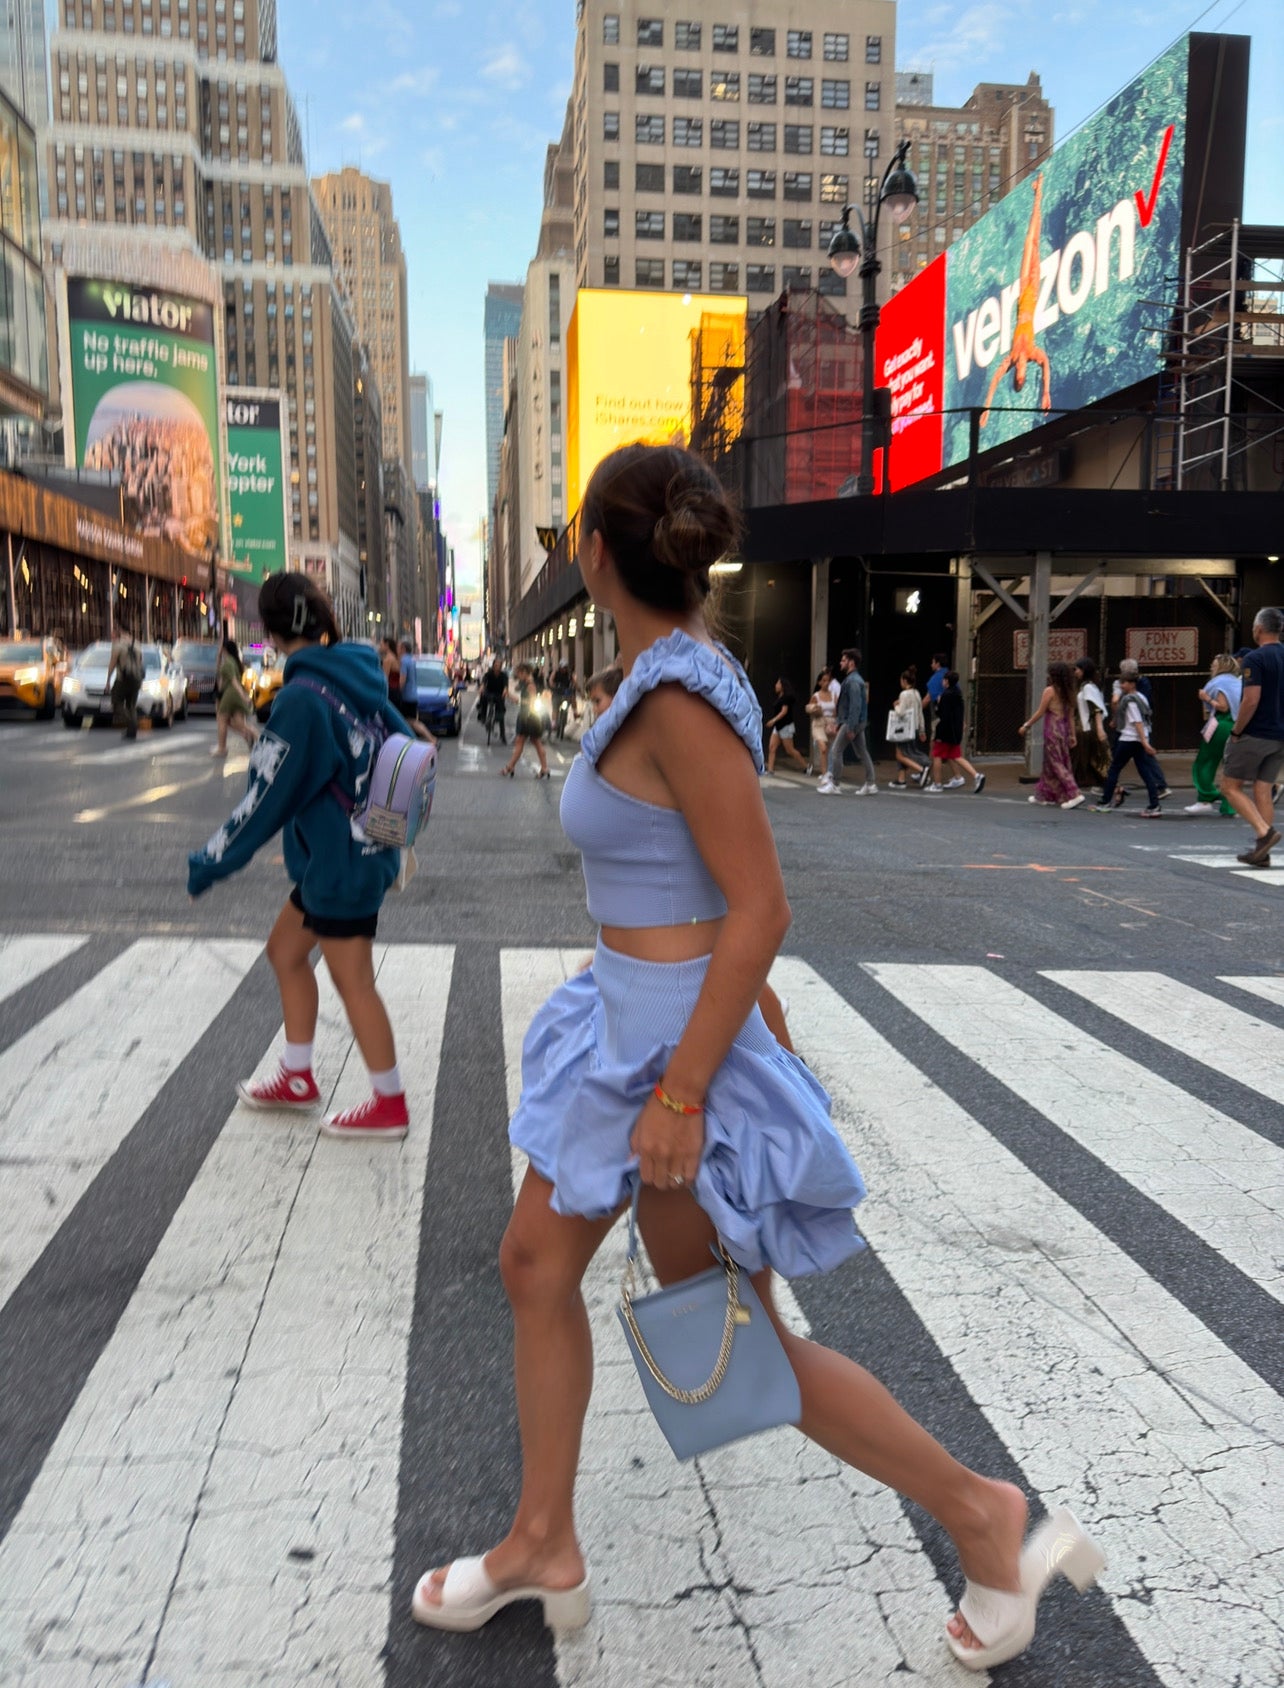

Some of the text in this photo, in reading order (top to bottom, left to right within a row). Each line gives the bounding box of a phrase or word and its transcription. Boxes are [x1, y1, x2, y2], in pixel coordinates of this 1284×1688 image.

[953, 199, 1136, 381] verzon
[84, 329, 208, 371] No traffic jams
[84, 352, 108, 374] up
[888, 373, 901, 394] hat
[227, 401, 260, 425] tor
[596, 395, 684, 411] Find out how
[228, 452, 267, 474] York
[229, 474, 275, 496] opter
[1021, 635, 1080, 648] EGENCY
[1145, 631, 1179, 646] FDNY
[1138, 647, 1187, 662] ACCESS
